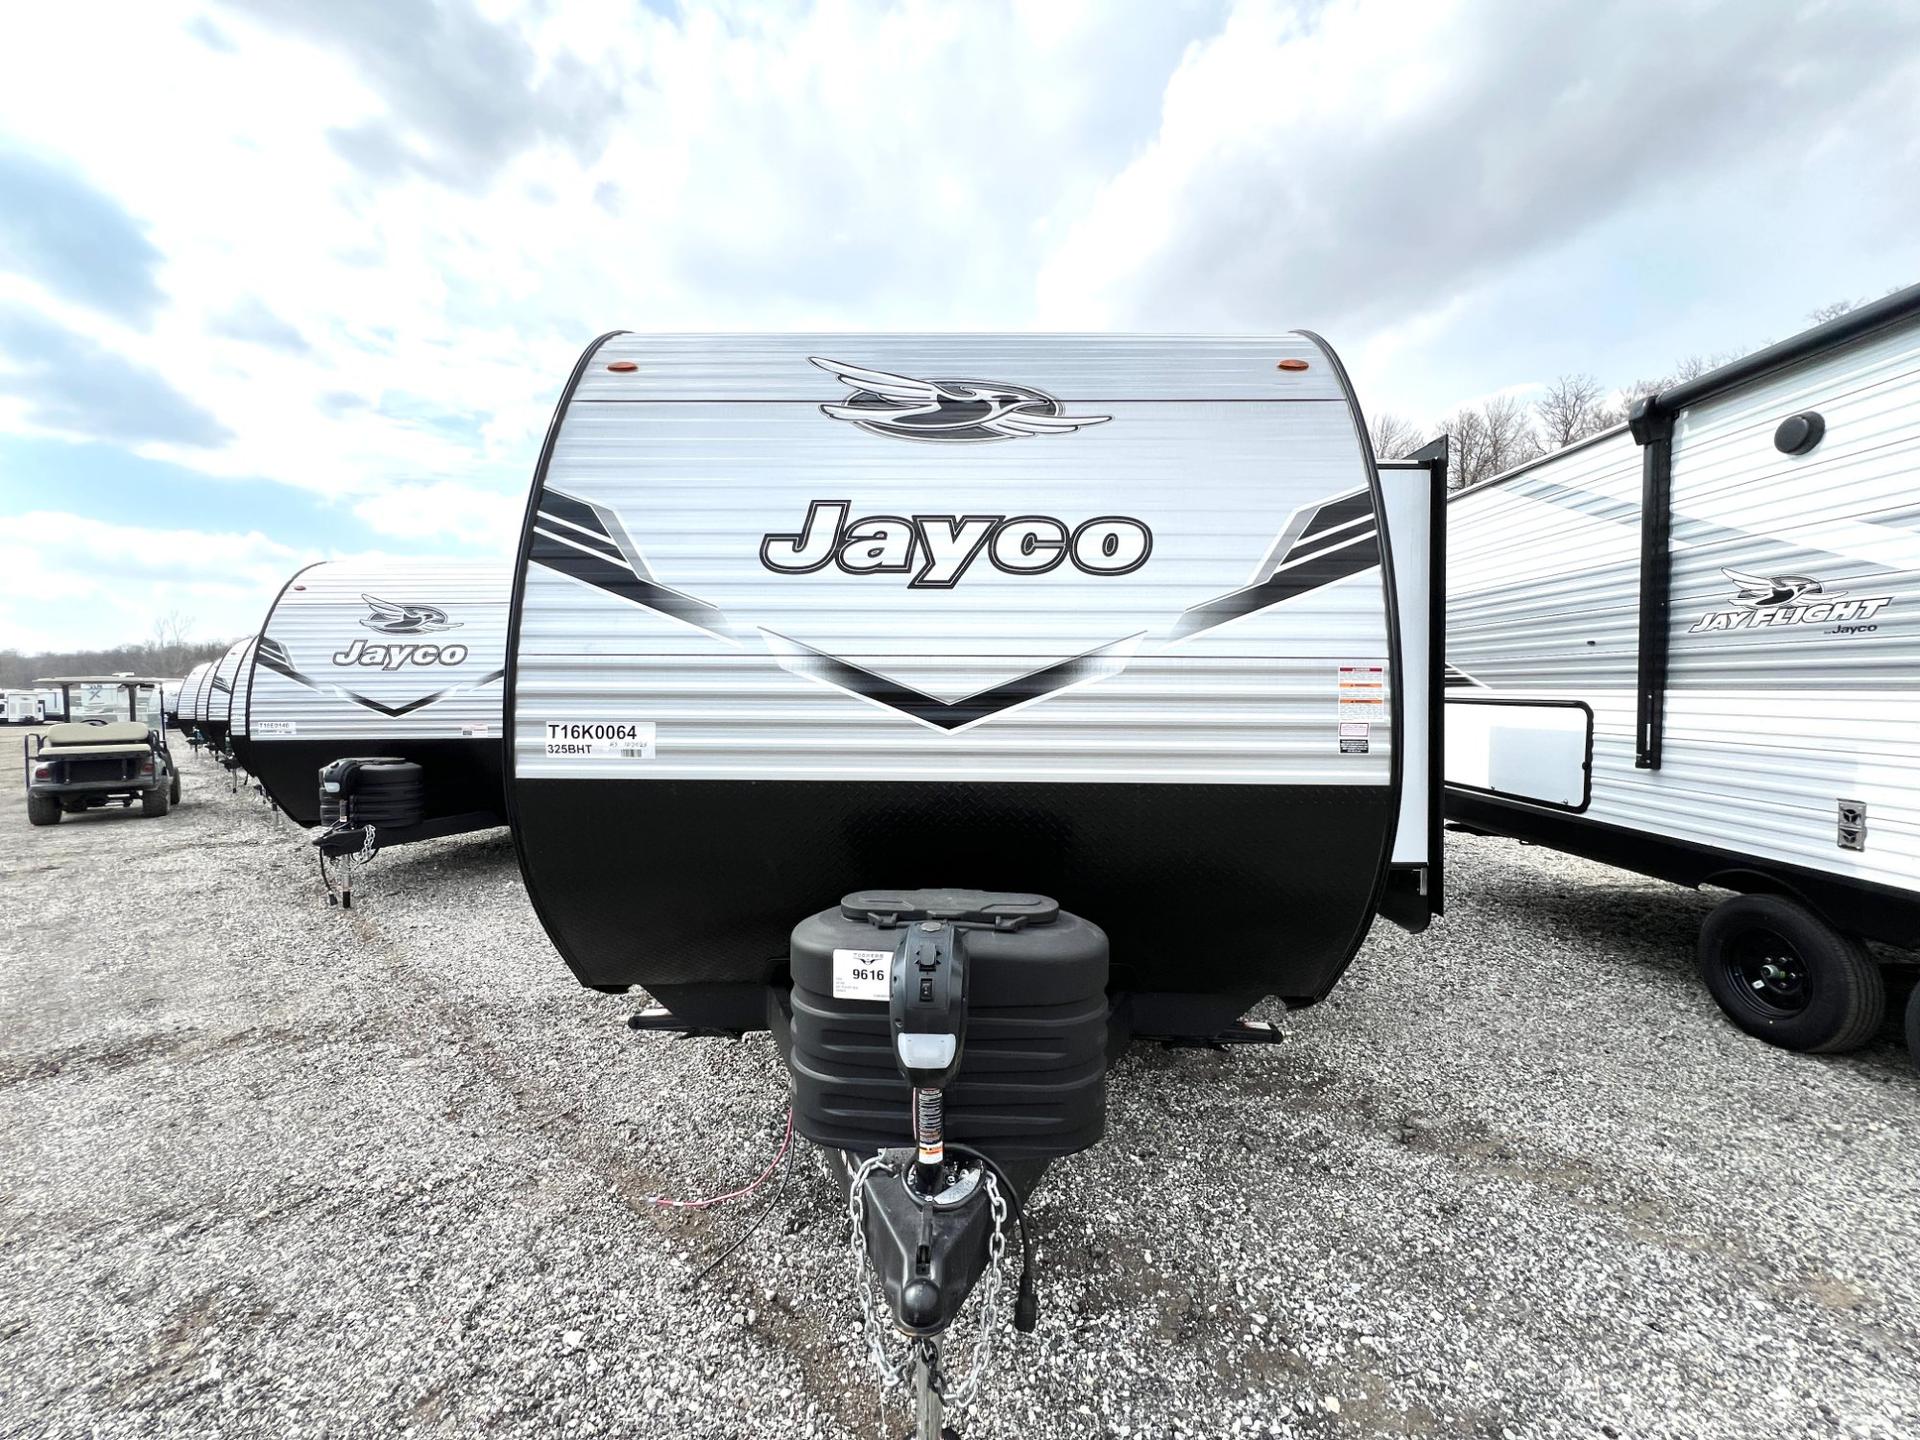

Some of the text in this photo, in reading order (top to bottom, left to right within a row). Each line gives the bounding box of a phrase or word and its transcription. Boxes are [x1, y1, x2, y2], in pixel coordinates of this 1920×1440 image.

[759, 499, 1153, 589] Jayco
[1688, 597, 1895, 633] JAY FLIGHT
[1831, 624, 1878, 635] Jayco
[332, 639, 468, 671] Jayco
[548, 724, 637, 740] T16K0064
[547, 744, 592, 754] 325BHT
[852, 968, 885, 981] 9616
